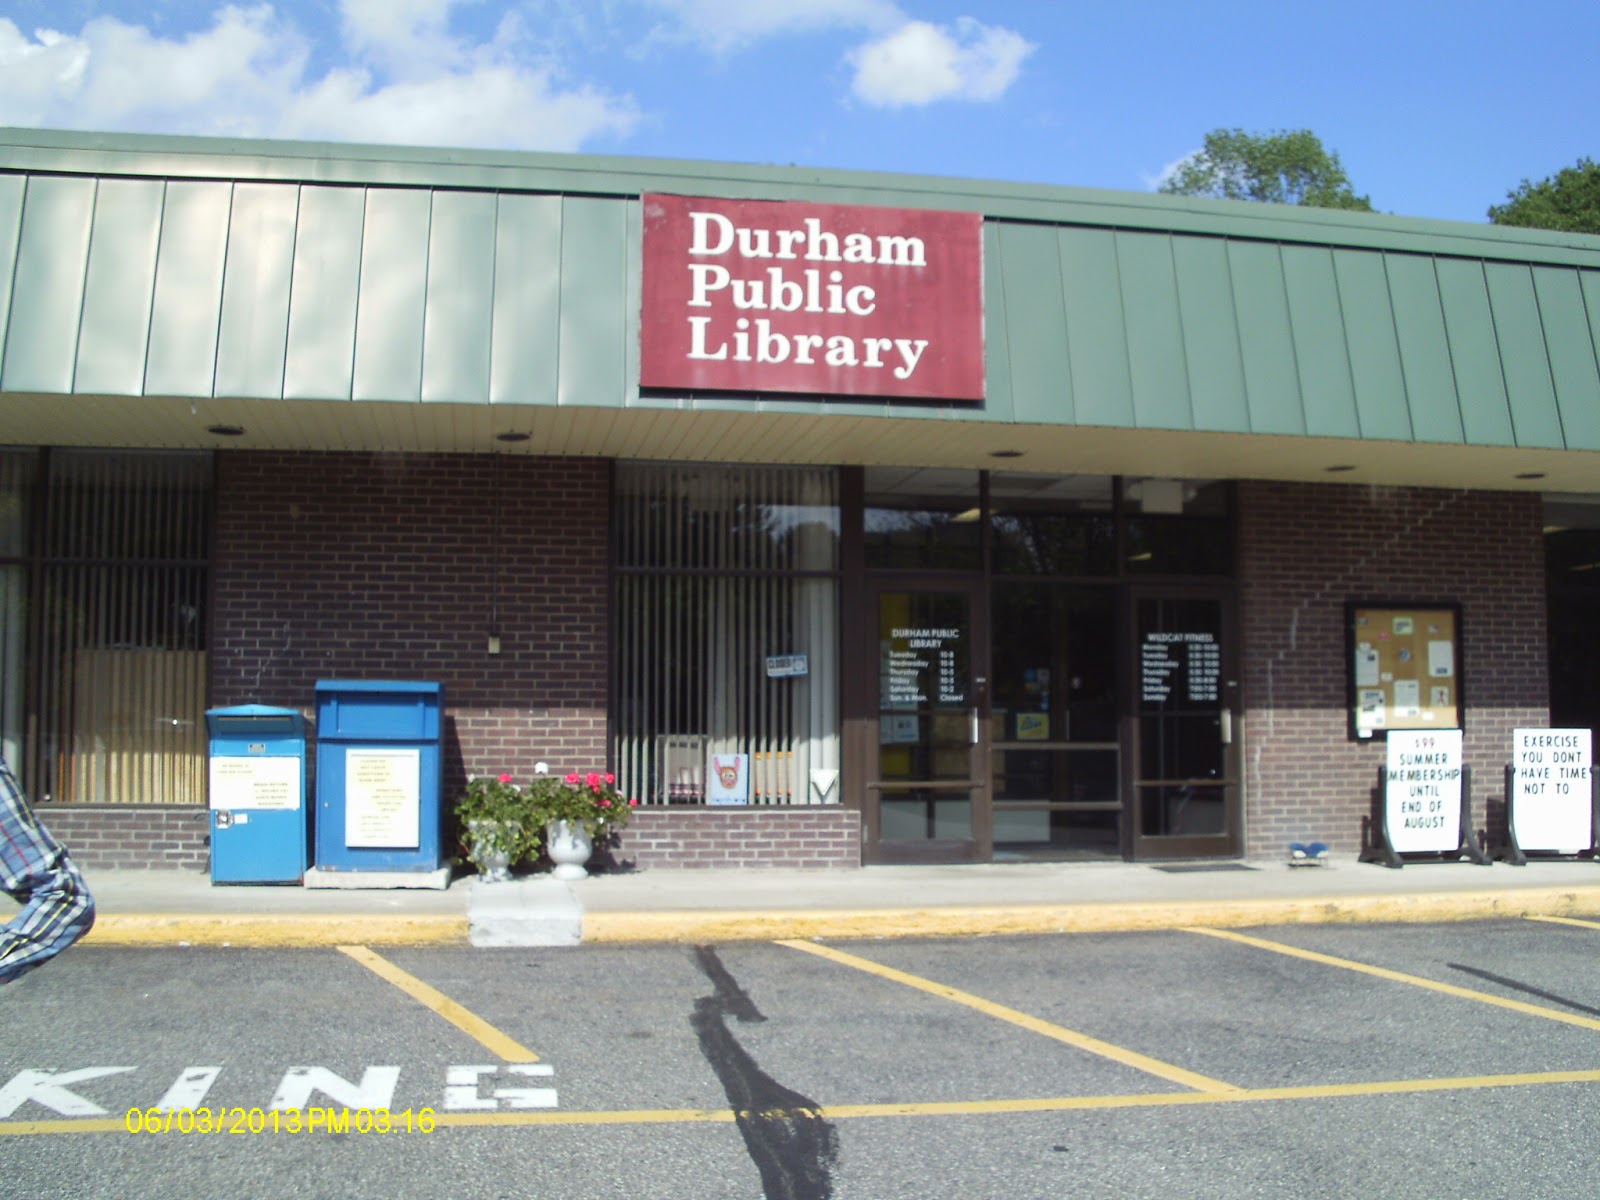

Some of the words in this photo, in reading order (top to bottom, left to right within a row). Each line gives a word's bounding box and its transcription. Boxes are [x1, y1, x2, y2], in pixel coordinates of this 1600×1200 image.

[688, 211, 927, 267] Durham
[687, 263, 876, 315] Public
[687, 316, 929, 380] Library
[892, 628, 930, 638] DURHAM
[931, 628, 960, 638] PUBLIC
[1147, 633, 1183, 642] WILDCAT
[1184, 633, 1214, 642] FITNESS
[910, 640, 942, 648] LIBRARY
[889, 651, 917, 660] Tuesday
[1143, 652, 1168, 660] Tuesday
[889, 660, 929, 668] Wednesday
[889, 668, 919, 677] Thursday
[1143, 669, 1170, 677] Thursday
[889, 677, 910, 685] Friday
[1143, 677, 1162, 685] Friday
[889, 685, 920, 694] Saturday
[1143, 685, 1171, 693] Saturday
[1524, 736, 1579, 748] EXERCISE
[1400, 754, 1448, 765] SUMMER
[1521, 752, 1543, 763] YOU
[1553, 752, 1582, 763] DONT
[1389, 769, 1460, 782] MEMBERSHIP
[1521, 768, 1550, 779] HAVE
[1560, 767, 1587, 779] TIME
[1410, 785, 1440, 797] UNTIL
[1524, 783, 1545, 795] NOT
[1556, 783, 1570, 795] TO
[1402, 801, 1422, 813] END
[1430, 801, 1442, 812] OF
[1405, 816, 1445, 829] AUGUST
